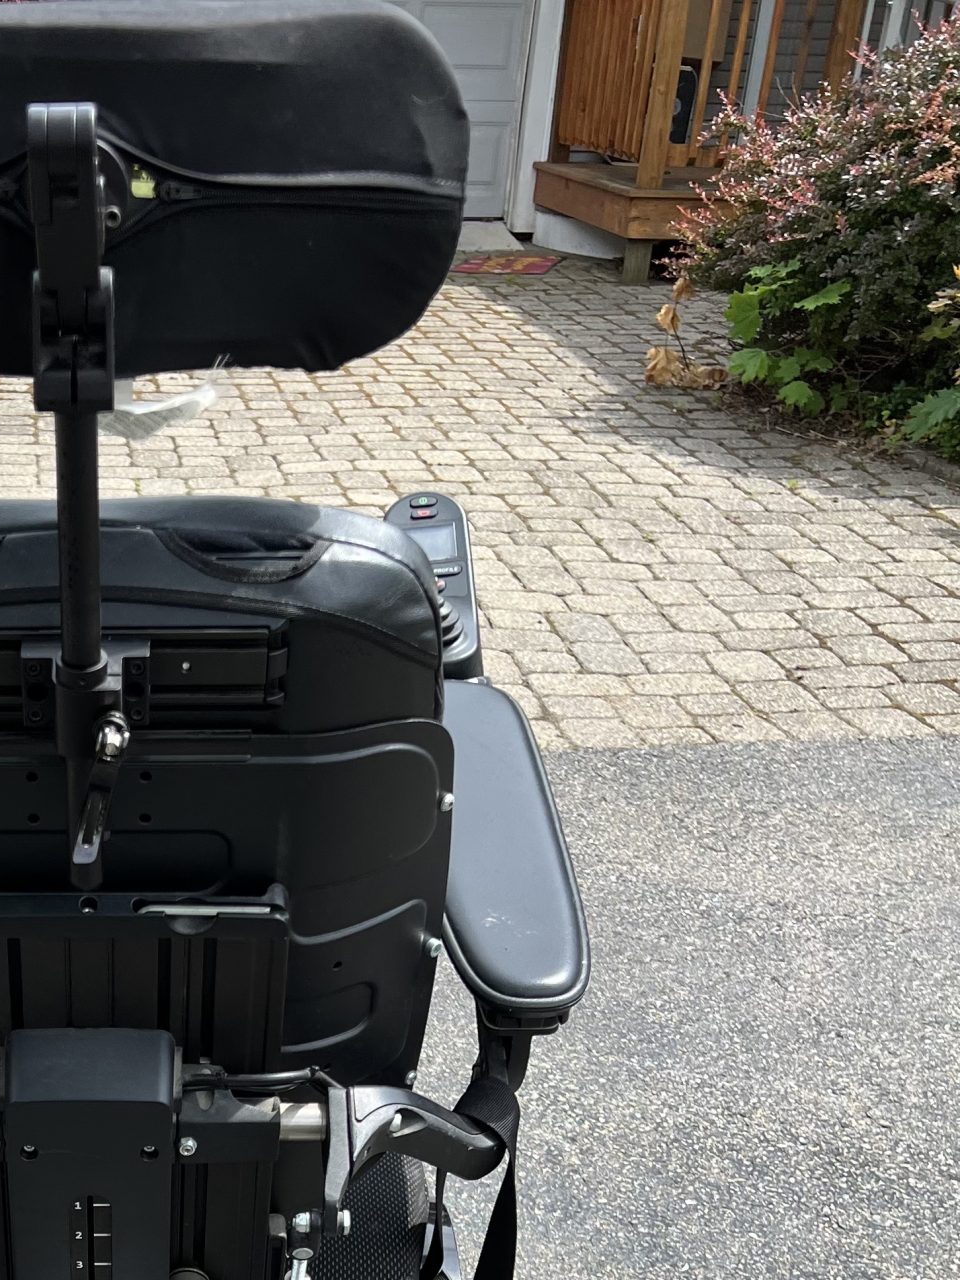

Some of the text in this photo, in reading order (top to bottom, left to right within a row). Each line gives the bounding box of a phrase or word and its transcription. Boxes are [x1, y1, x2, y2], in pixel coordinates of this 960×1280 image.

[74, 1202, 82, 1210] 1
[75, 1231, 83, 1239] 2
[76, 1261, 83, 1269] 3
